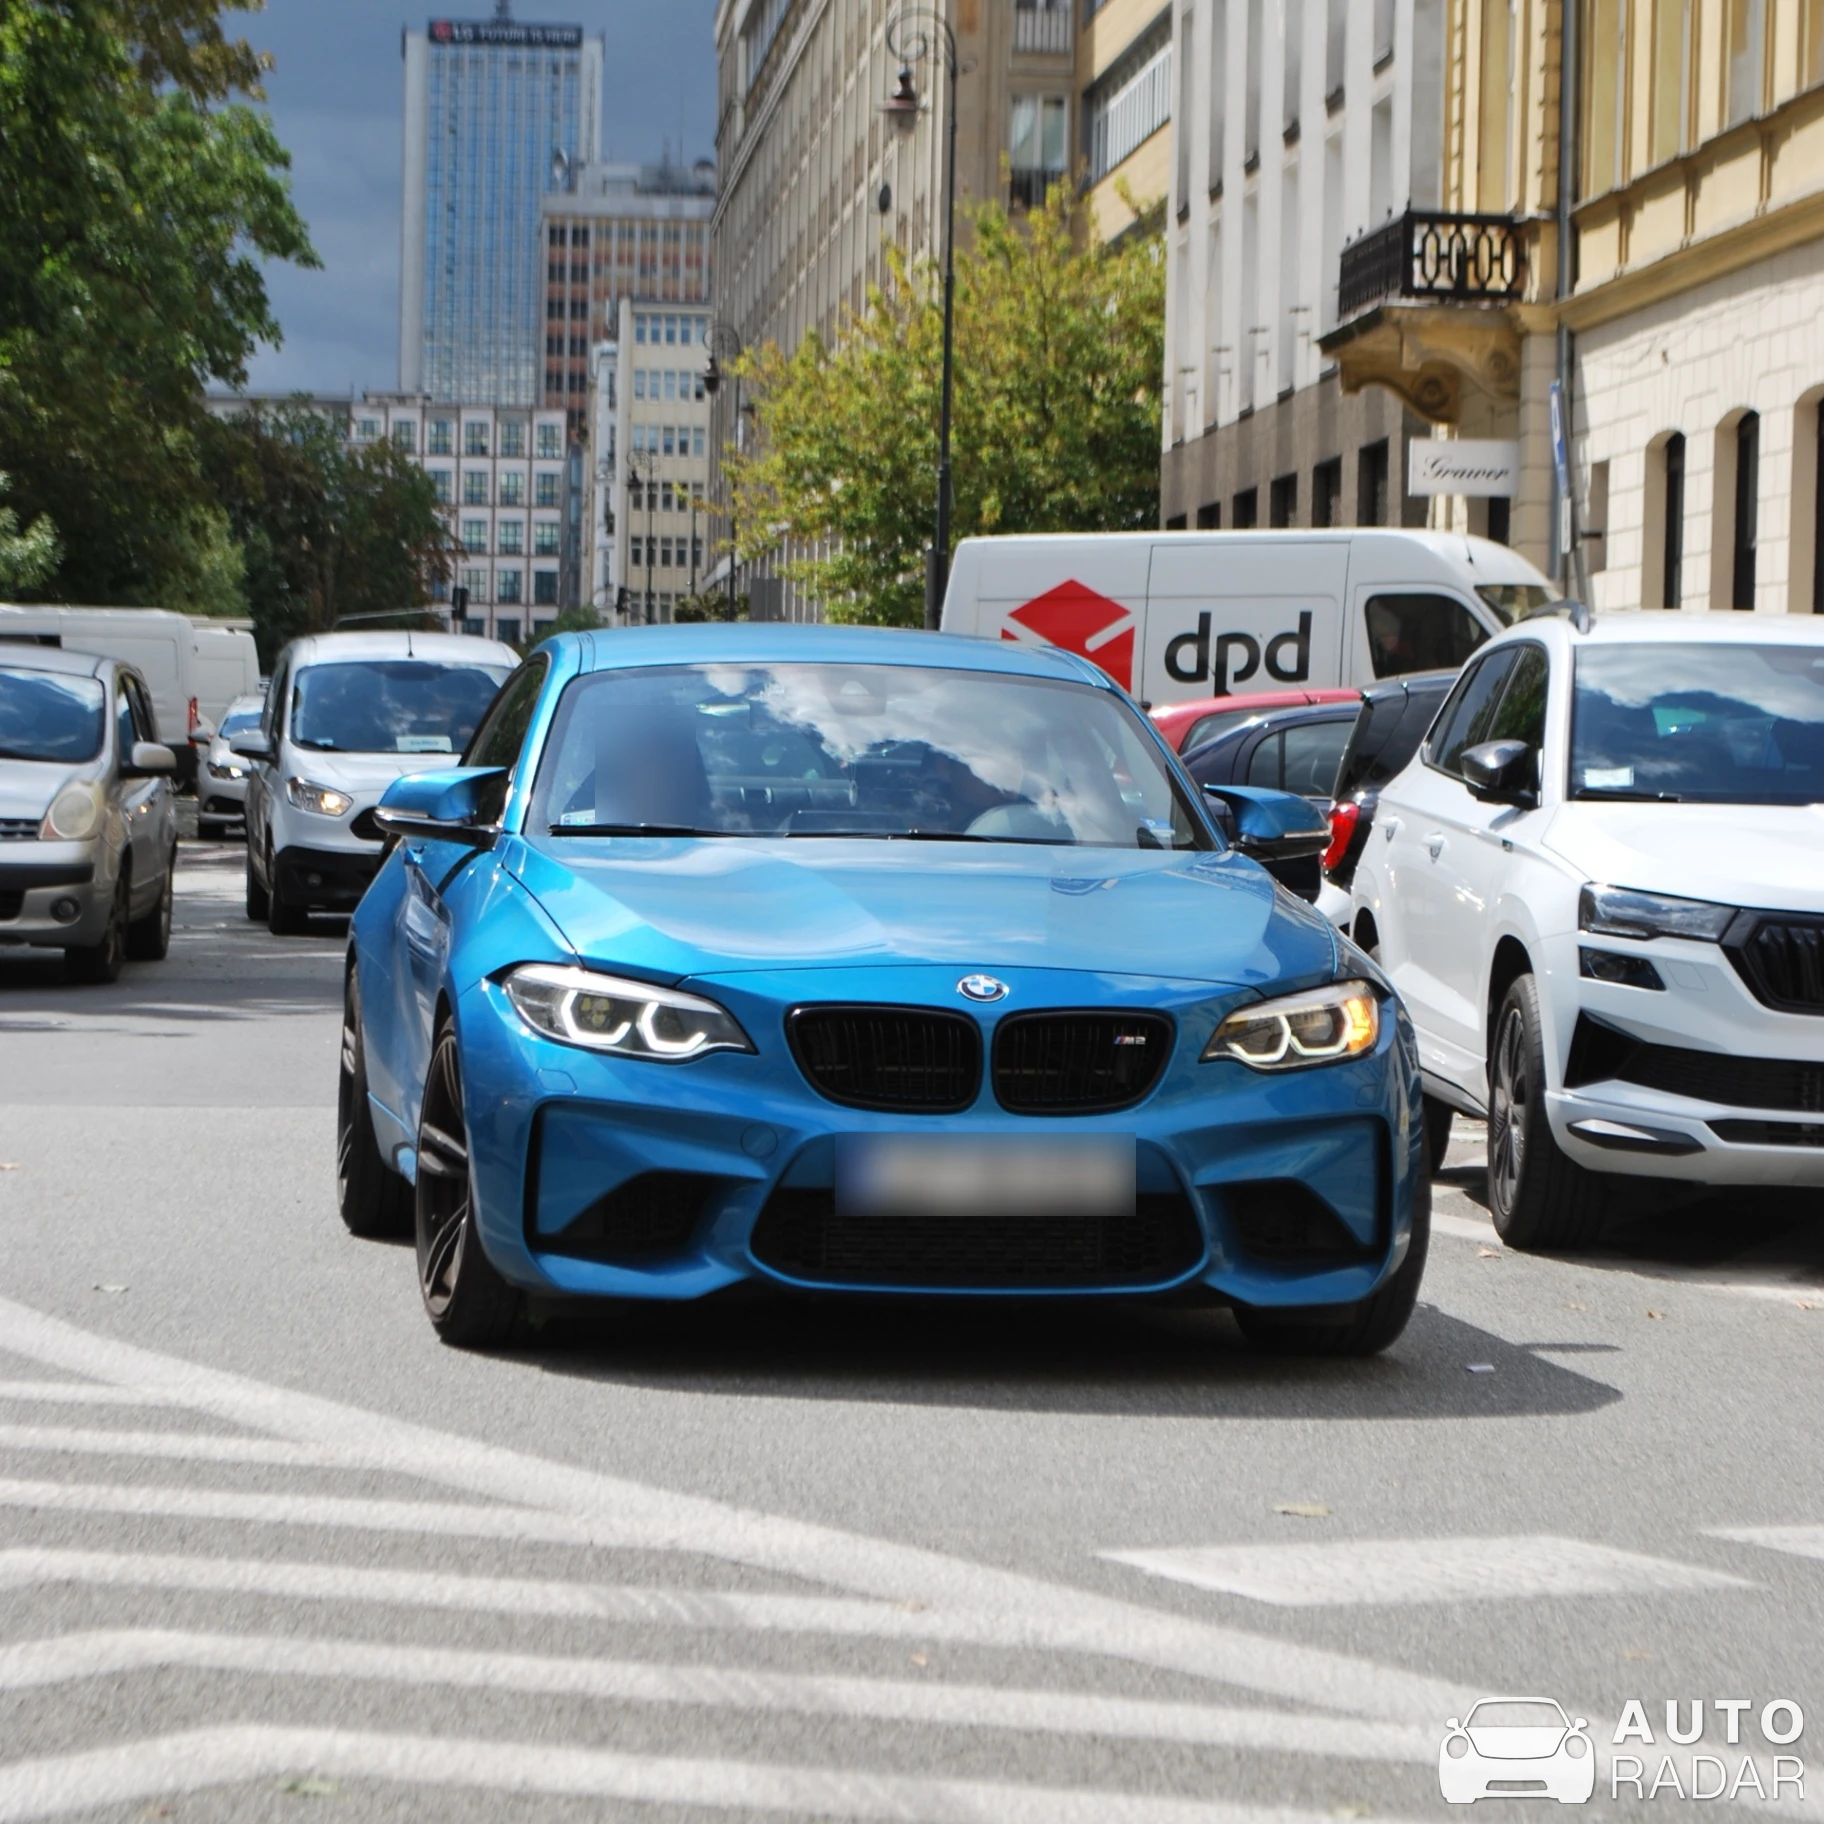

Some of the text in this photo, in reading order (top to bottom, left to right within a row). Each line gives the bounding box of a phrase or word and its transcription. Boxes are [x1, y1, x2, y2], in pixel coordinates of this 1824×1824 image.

[1423, 455, 1510, 480] Grawer
[1164, 610, 1312, 698] dpd
[1121, 1035, 1146, 1045] M2
